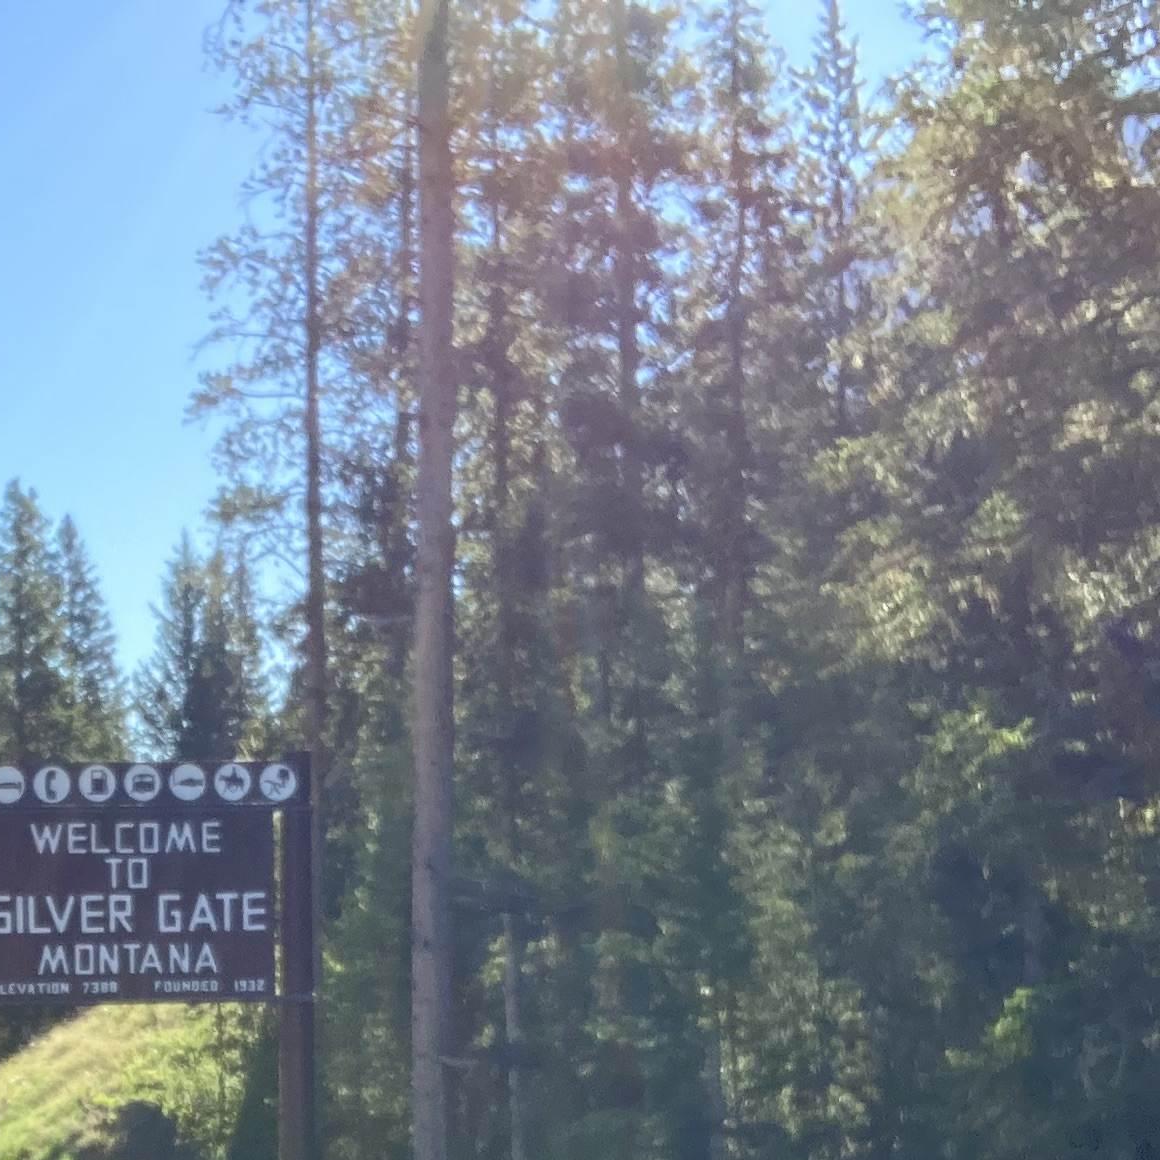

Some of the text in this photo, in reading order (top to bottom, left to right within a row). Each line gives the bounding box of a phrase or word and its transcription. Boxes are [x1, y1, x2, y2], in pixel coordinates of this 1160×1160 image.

[30, 821, 222, 854] WELCOME
[105, 857, 149, 889] TO
[158, 892, 267, 933] GATE
[39, 943, 218, 975] MONTANA
[154, 980, 219, 992] FOUNDED
[234, 979, 265, 992] 1932
